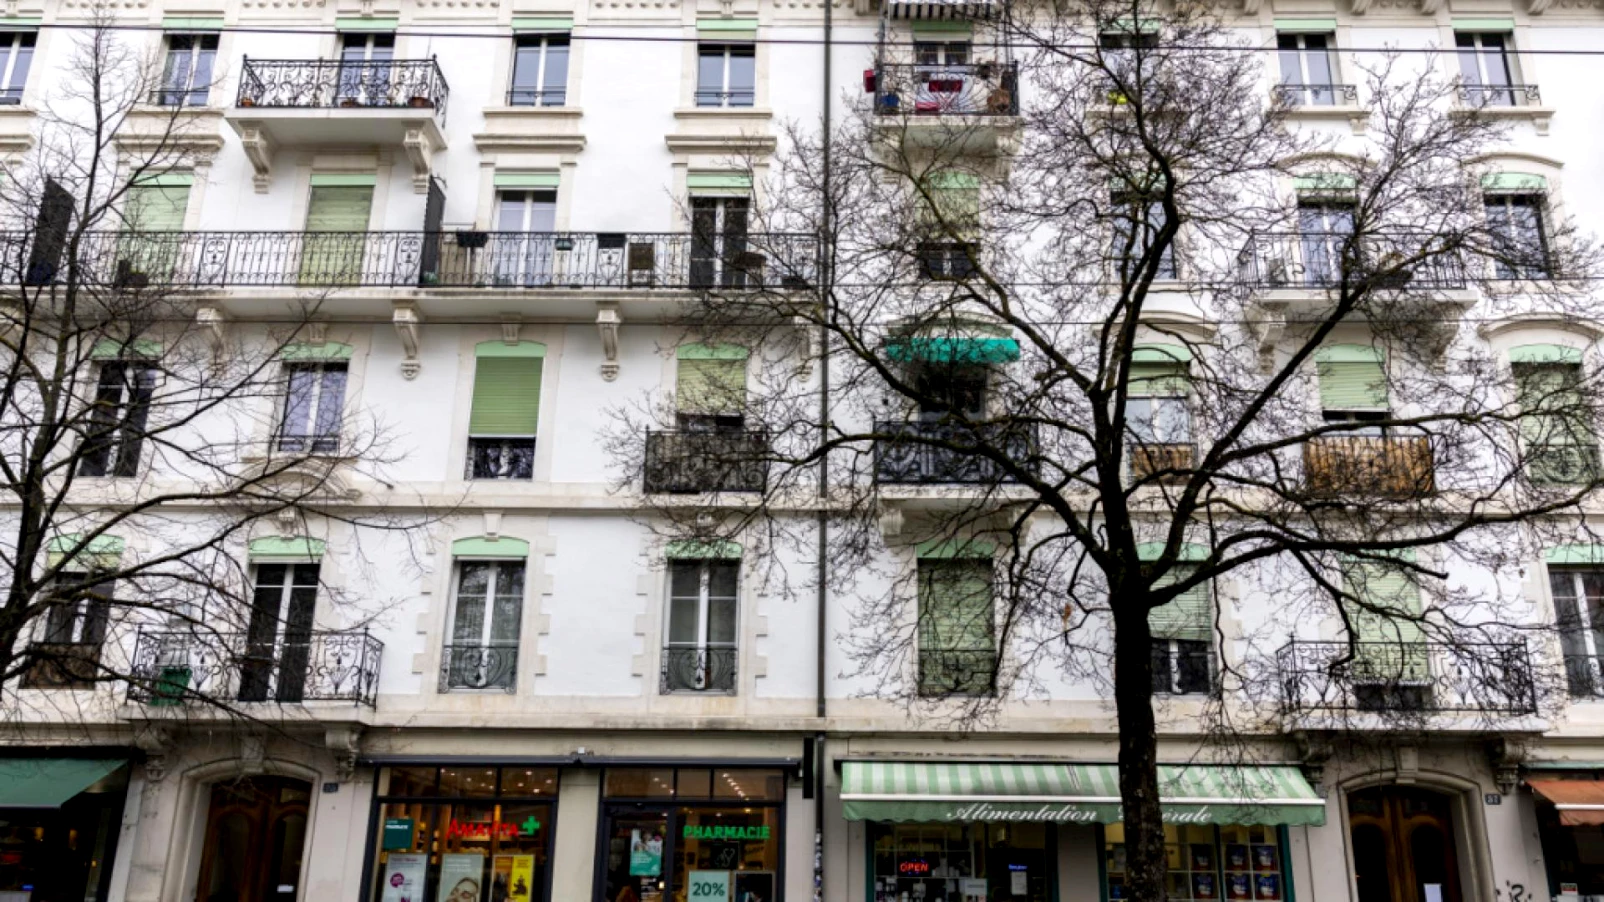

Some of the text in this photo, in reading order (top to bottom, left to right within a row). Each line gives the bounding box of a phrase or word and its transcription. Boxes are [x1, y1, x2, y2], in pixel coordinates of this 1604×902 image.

[947, 803, 1212, 822] Alimentation érale
[683, 825, 770, 839] PHARMACIE
[900, 862, 929, 872] OPEN
[692, 882, 725, 896] 20%
